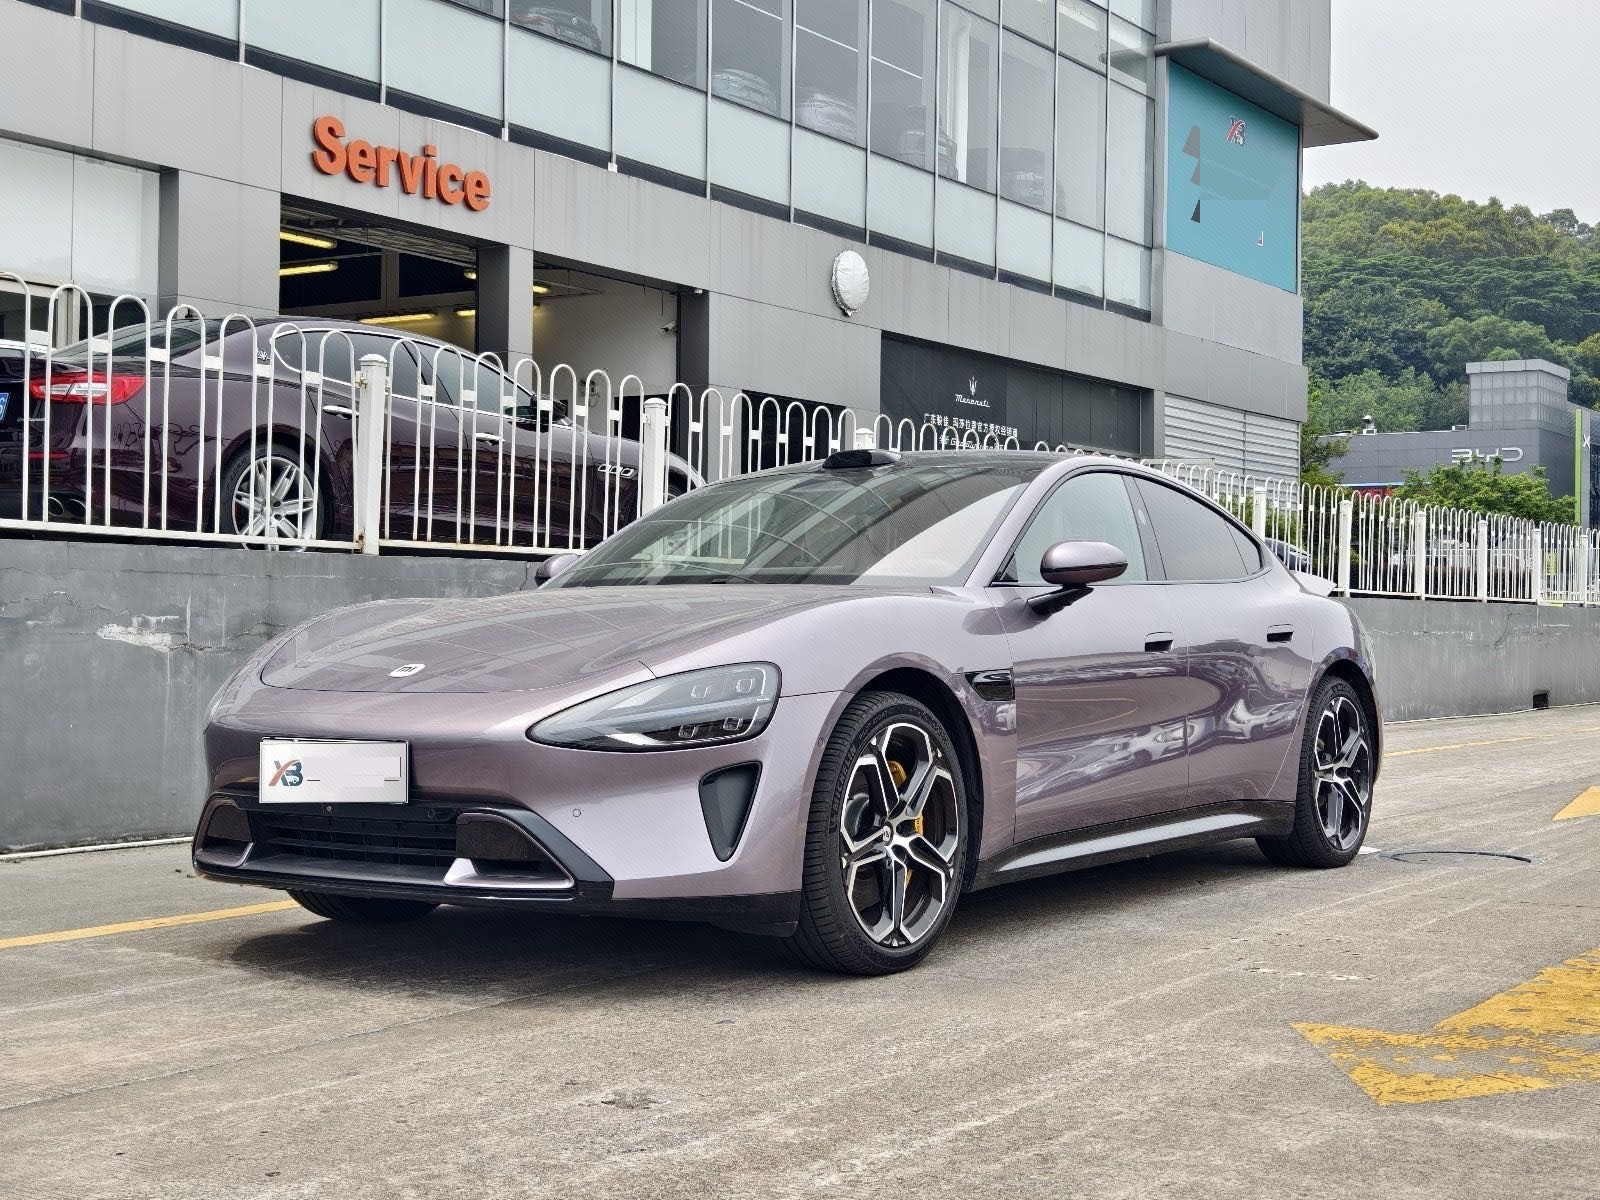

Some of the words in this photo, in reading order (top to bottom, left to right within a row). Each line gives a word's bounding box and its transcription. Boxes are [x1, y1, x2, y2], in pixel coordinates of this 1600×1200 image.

[312, 115, 491, 211] Service
[954, 393, 991, 408] Maserati
[1451, 446, 1524, 463] BYD
